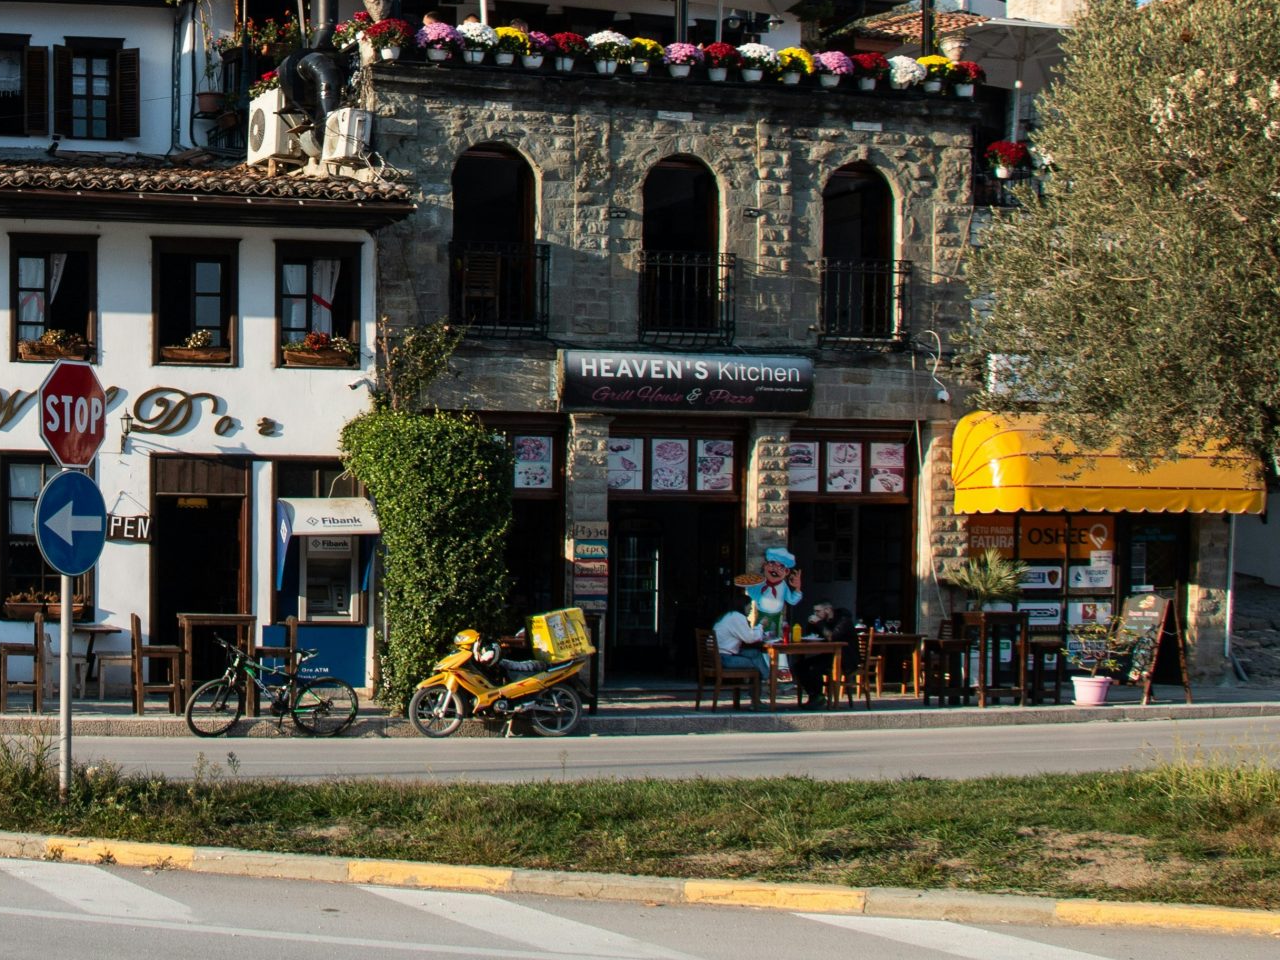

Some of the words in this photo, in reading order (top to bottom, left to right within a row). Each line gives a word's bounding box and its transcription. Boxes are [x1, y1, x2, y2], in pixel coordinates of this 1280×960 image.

[581, 358, 709, 380] HEAVEN'S
[718, 362, 801, 383] Kitchen
[591, 386, 635, 402] Grill
[636, 386, 684, 402] House
[686, 388, 702, 405] &
[705, 389, 756, 405] Pizza
[46, 393, 104, 435] STOP
[108, 516, 150, 538] PEN
[321, 516, 361, 525] Fibank
[1028, 528, 1087, 544] OSHEE
